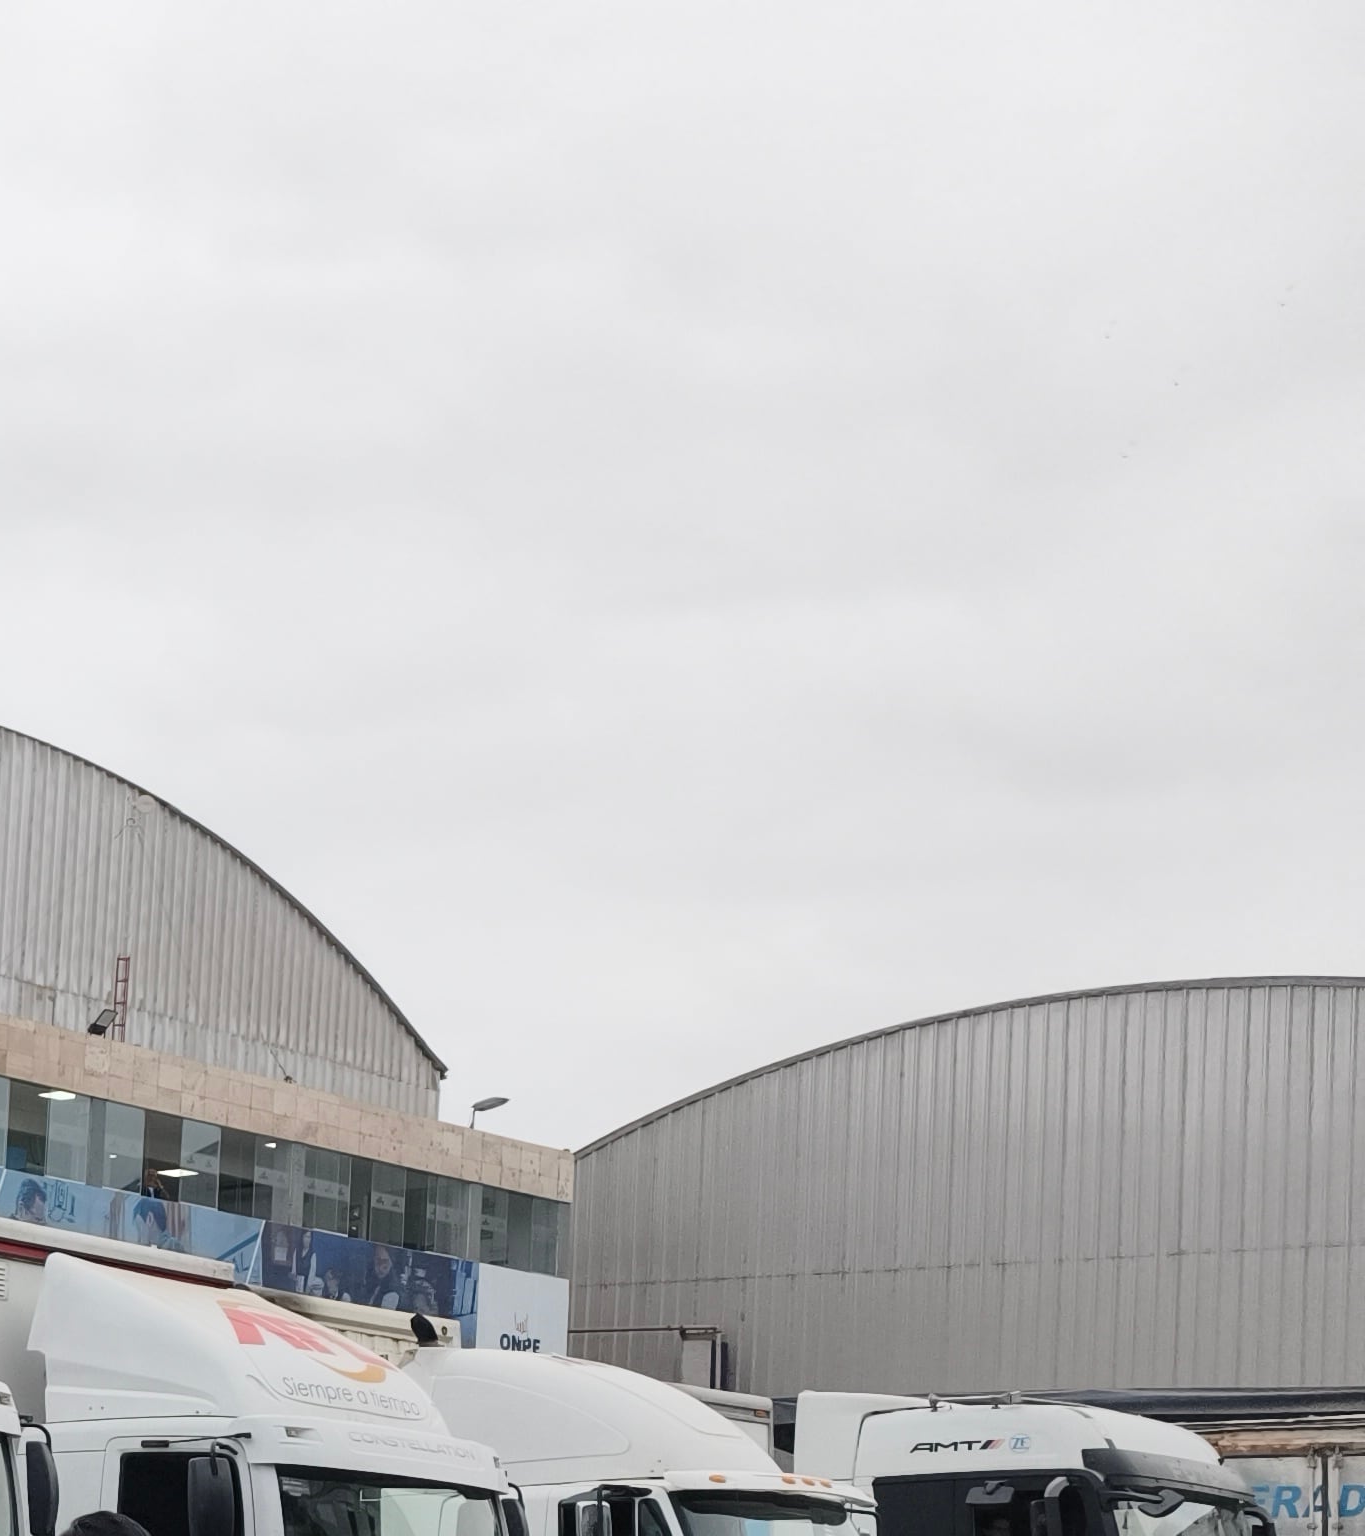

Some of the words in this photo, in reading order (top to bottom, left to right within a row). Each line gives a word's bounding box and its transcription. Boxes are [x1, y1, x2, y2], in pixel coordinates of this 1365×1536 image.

[499, 1333, 541, 1353] ONPE
[282, 1376, 353, 1404] Siempre
[357, 1390, 369, 1405] a
[369, 1390, 421, 1417] tiempo
[348, 1430, 475, 1461] CONSTELLATION
[910, 1440, 981, 1453] AMT
